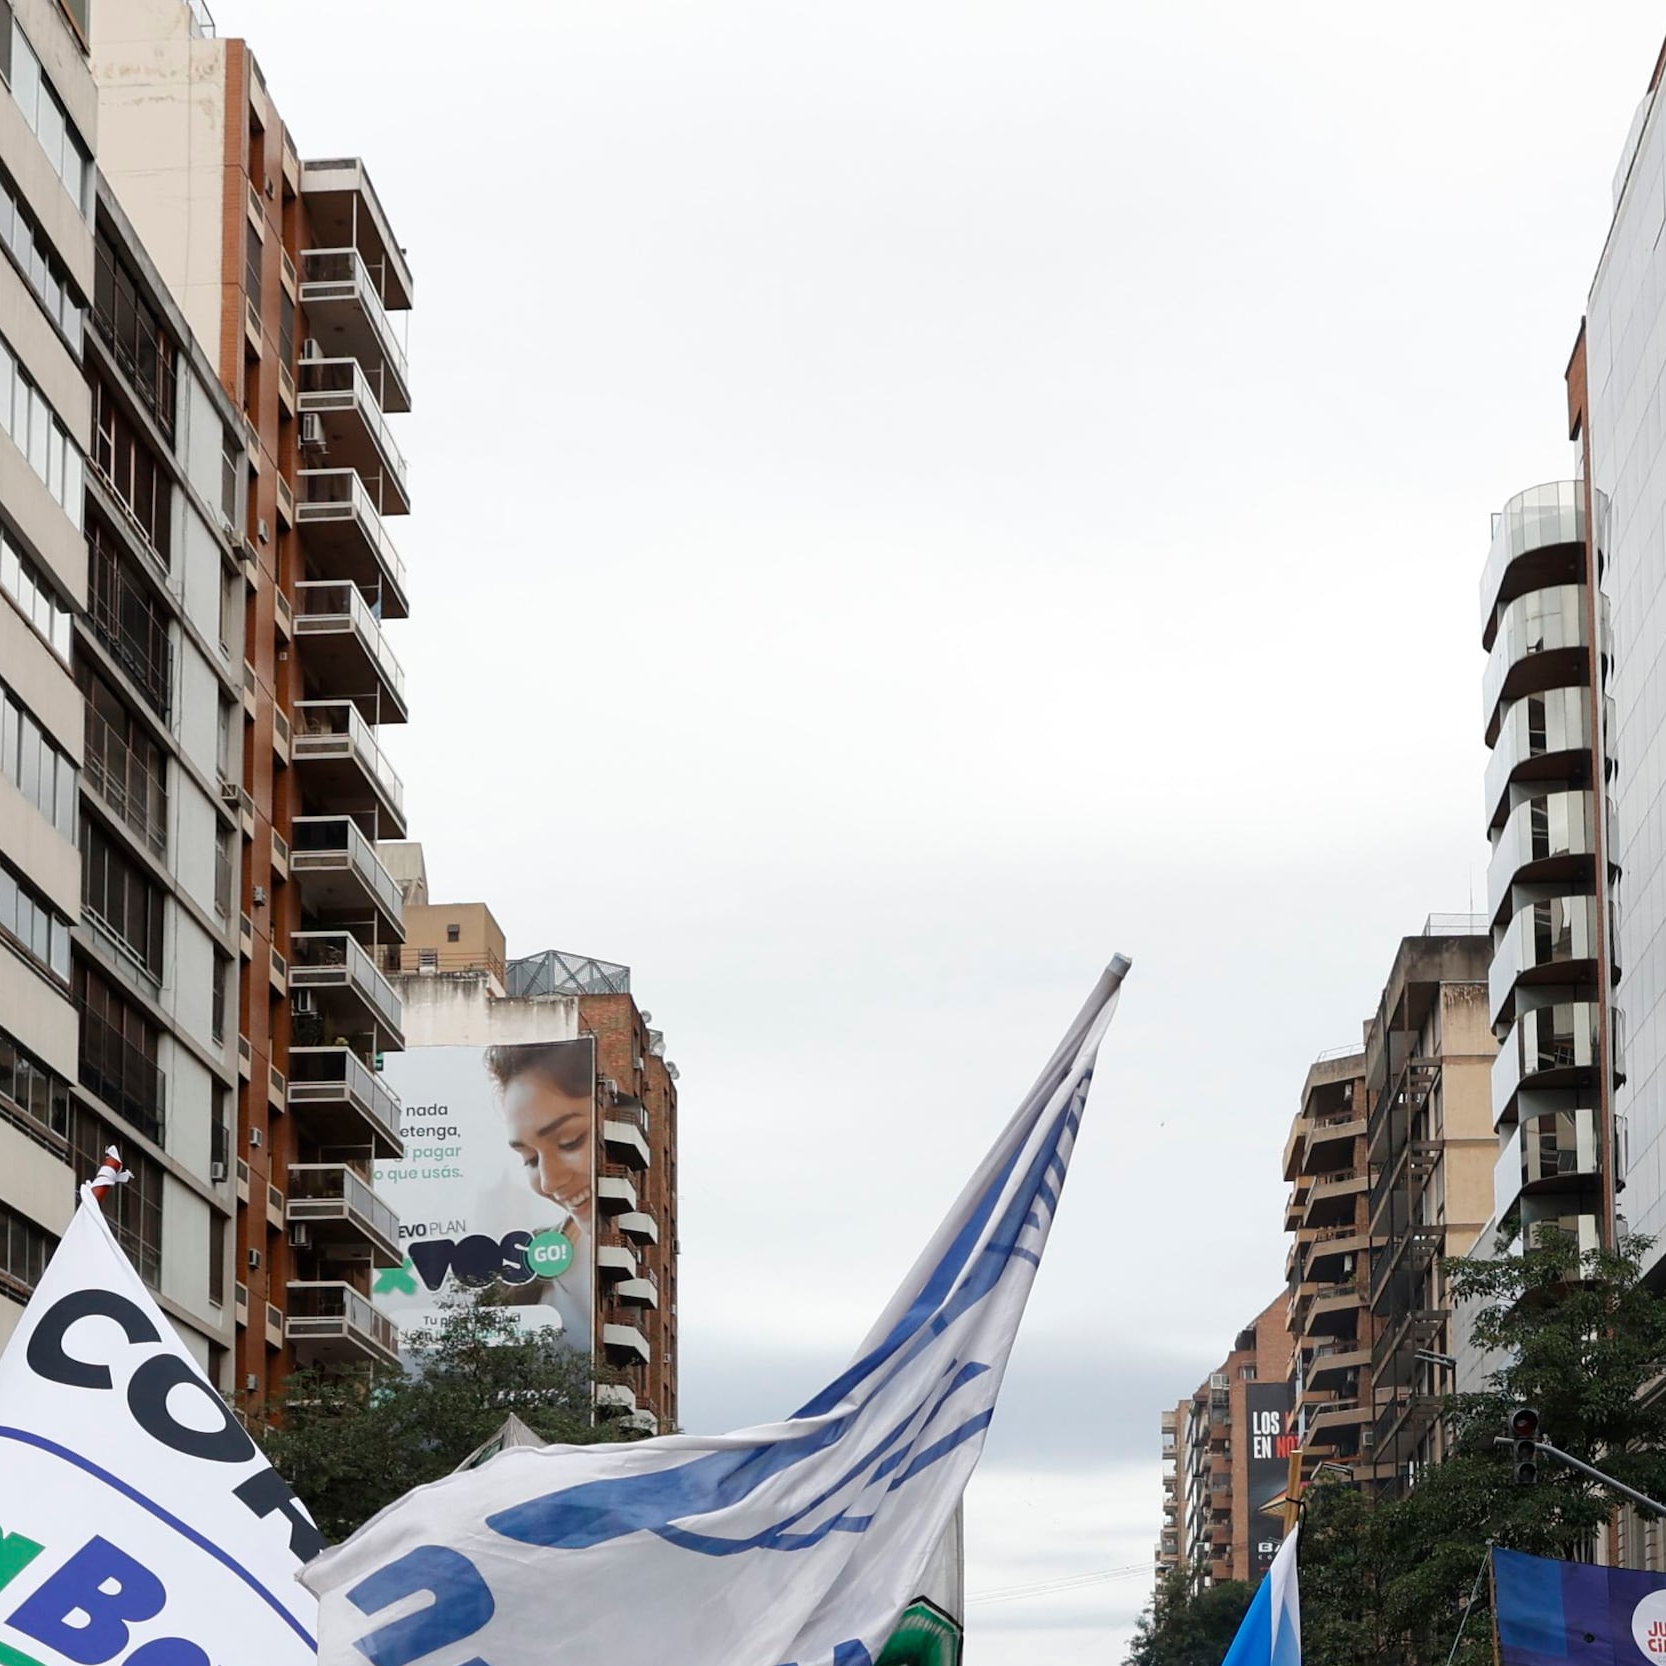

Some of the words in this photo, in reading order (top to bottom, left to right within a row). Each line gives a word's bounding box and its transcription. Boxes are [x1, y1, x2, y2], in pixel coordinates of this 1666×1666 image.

[406, 1103, 448, 1117] nada
[413, 1145, 462, 1161] pagar
[387, 1169, 418, 1184] que
[422, 1165, 464, 1179] usás.
[429, 1219, 466, 1237] PLAN
[534, 1244, 567, 1262] GO!
[1253, 1411, 1280, 1435] LOS
[1253, 1436, 1272, 1459] EN
